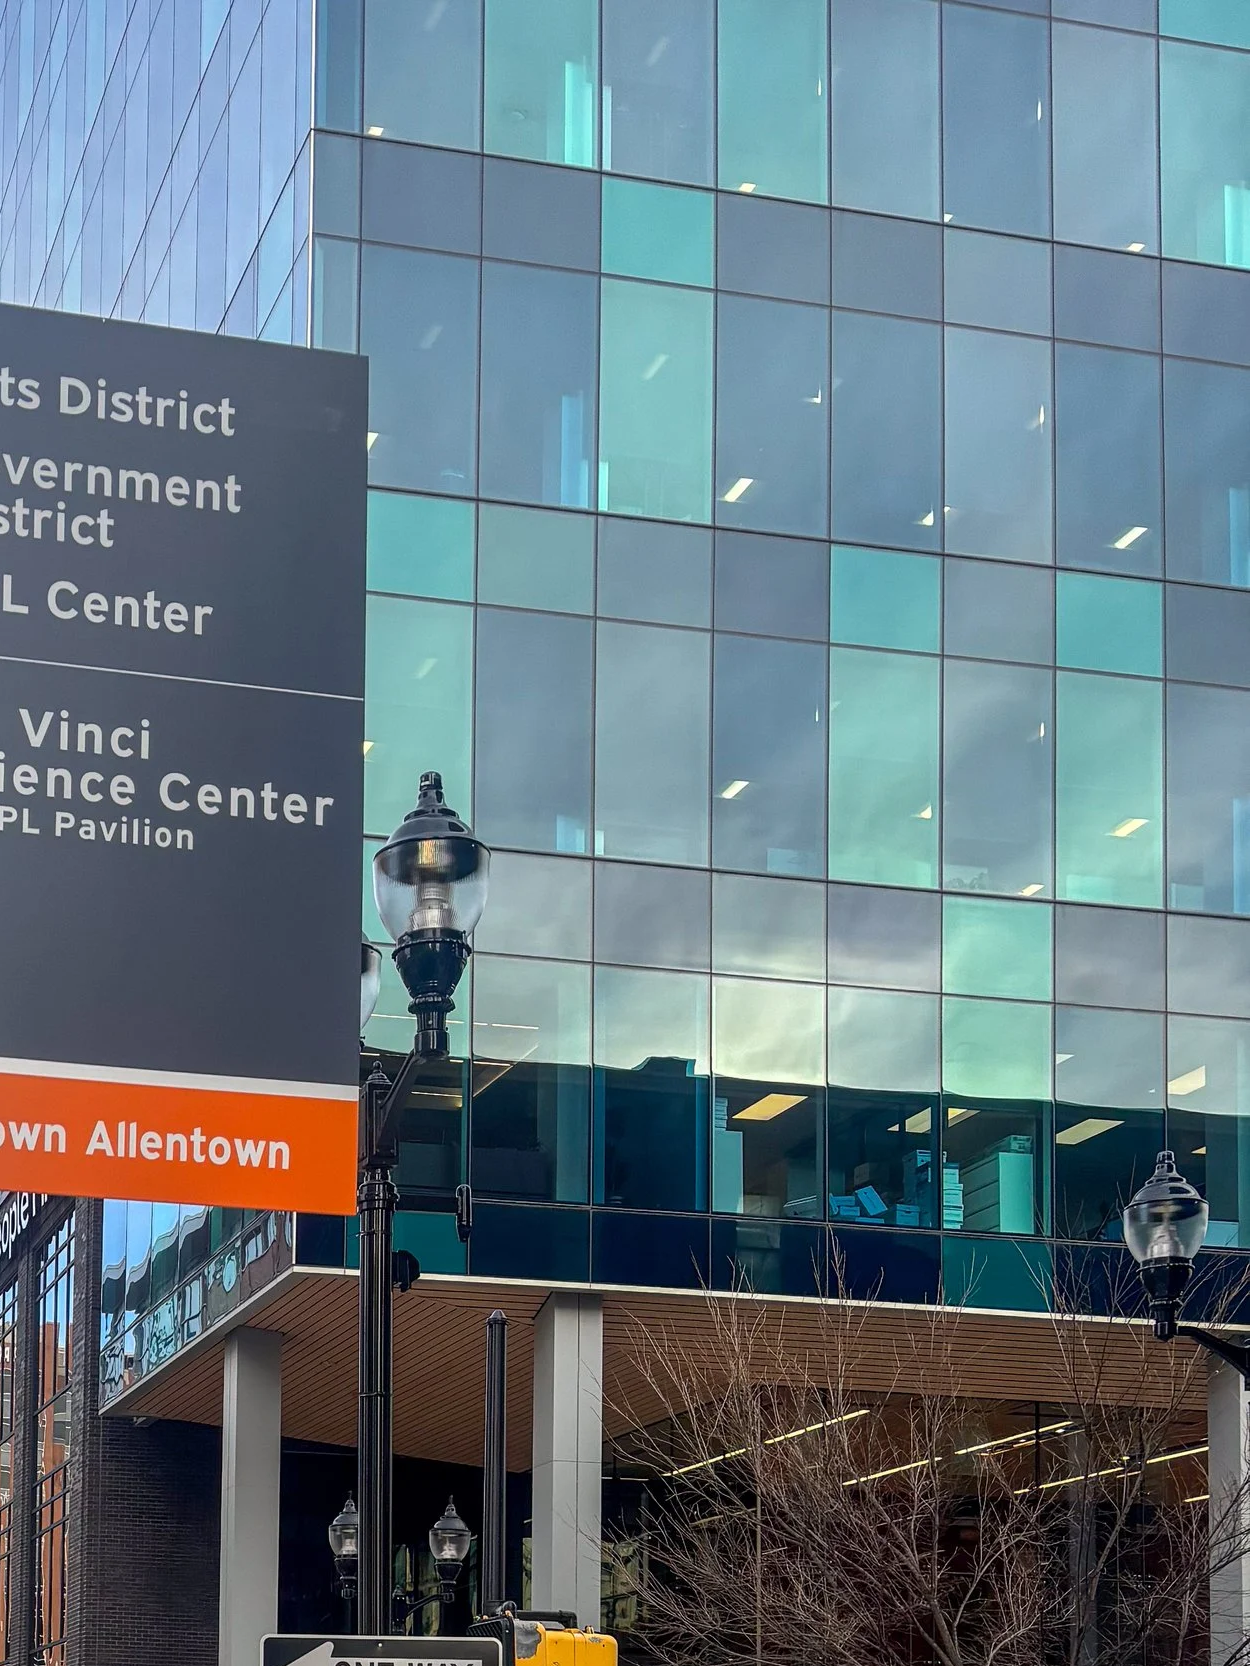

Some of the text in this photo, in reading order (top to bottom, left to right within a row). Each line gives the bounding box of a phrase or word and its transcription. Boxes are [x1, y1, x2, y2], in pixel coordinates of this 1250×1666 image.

[59, 376, 236, 437] District
[48, 580, 214, 635] Center
[18, 708, 151, 759] Vinci
[159, 773, 335, 827] Center
[55, 811, 195, 850] Pavilion
[86, 1120, 291, 1170] Allentown
